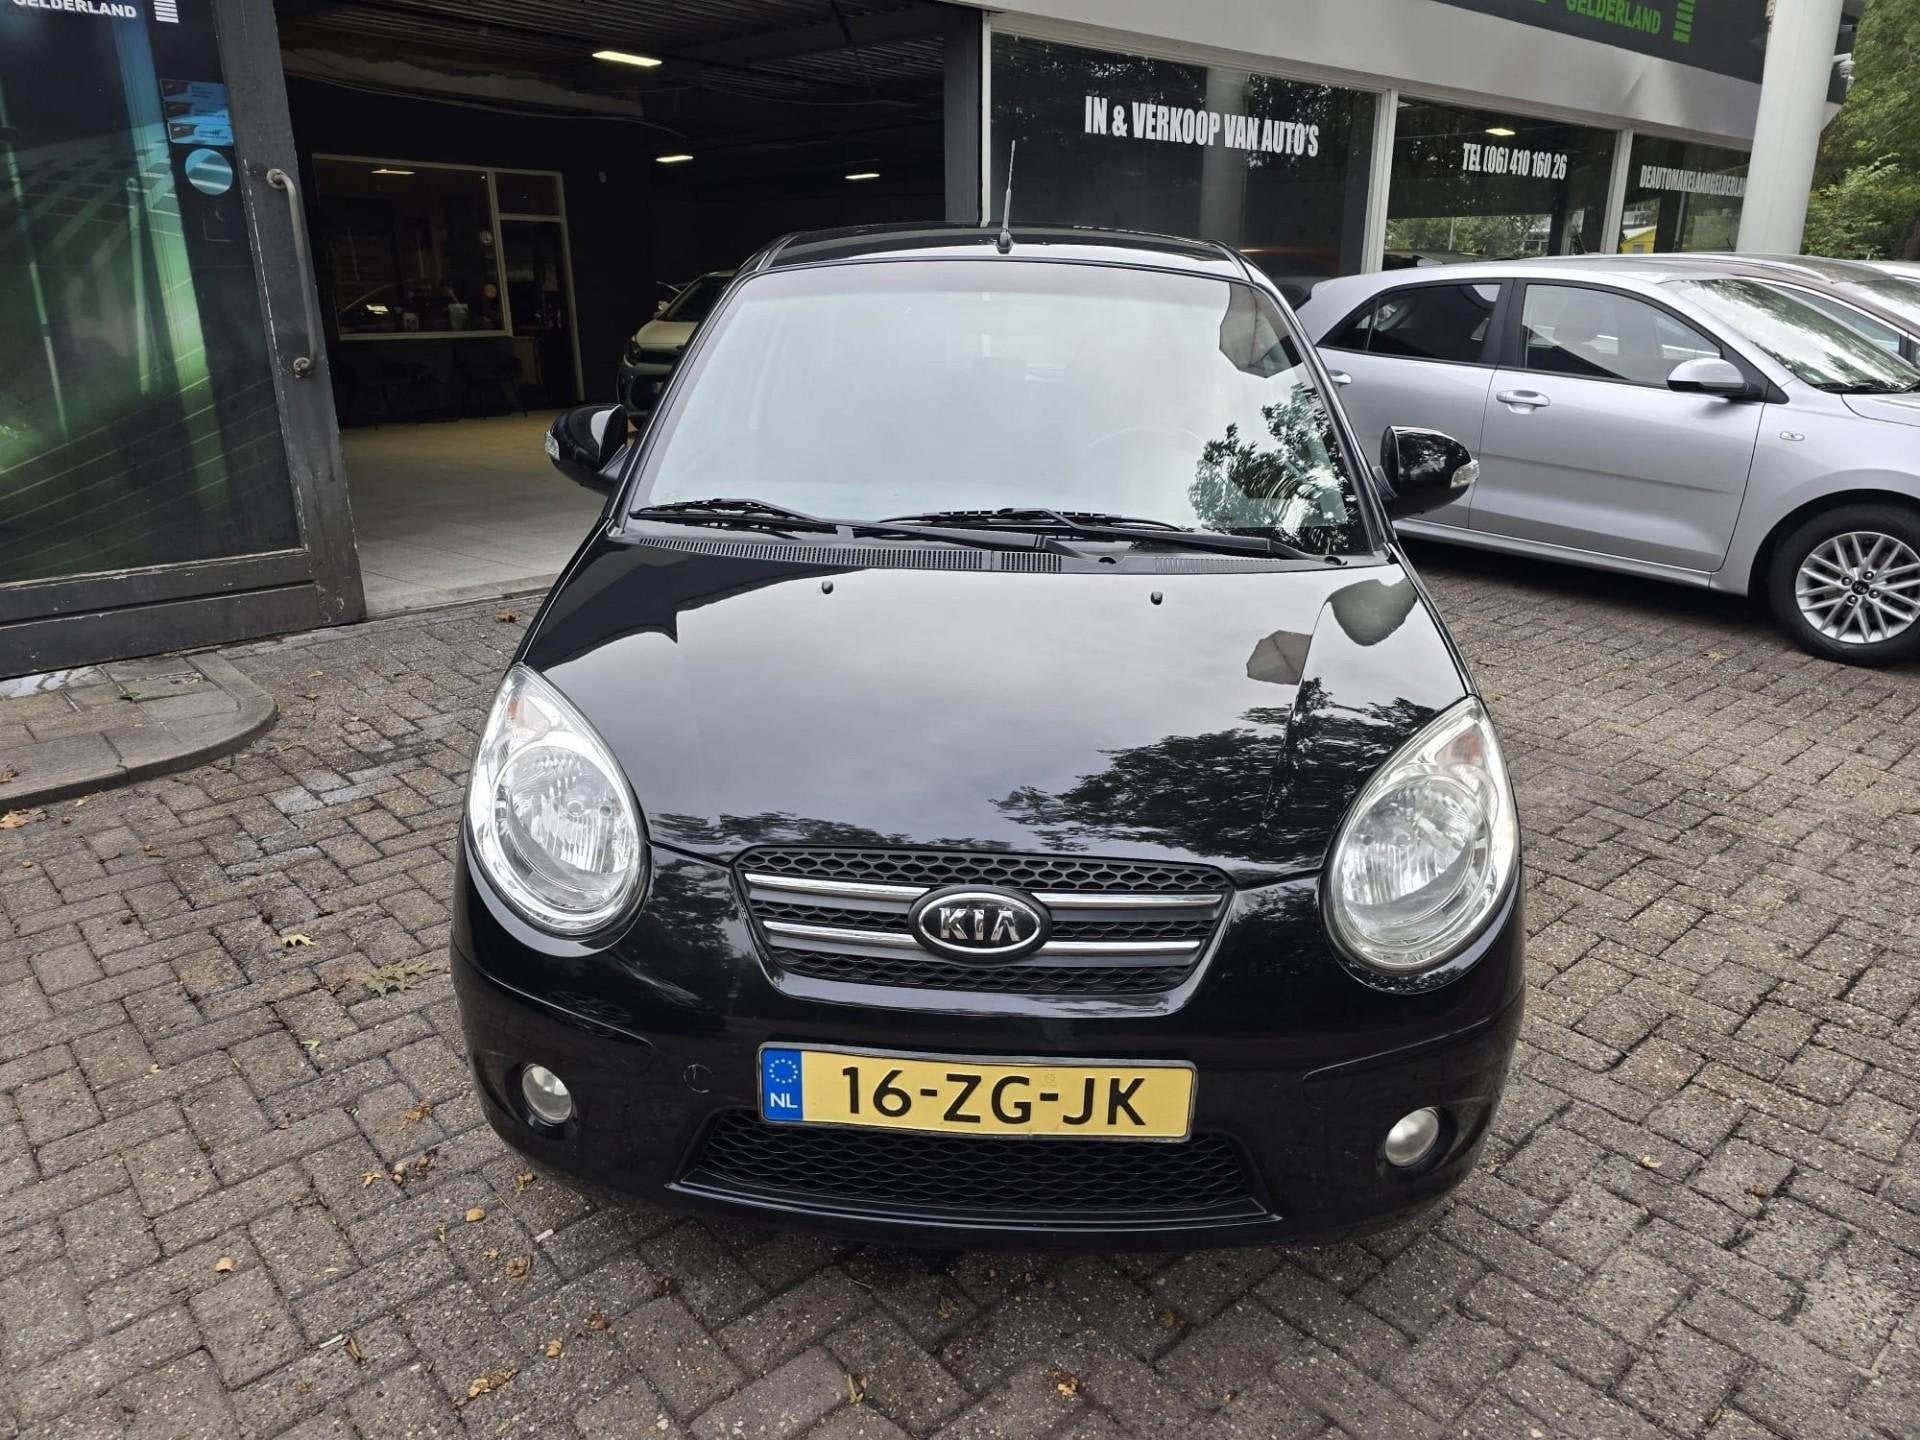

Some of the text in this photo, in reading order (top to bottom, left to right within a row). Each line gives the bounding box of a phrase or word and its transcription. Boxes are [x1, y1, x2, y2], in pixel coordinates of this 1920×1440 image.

[1085, 95, 1319, 157] IN & VERKOOP VAN AUTO'S
[1463, 142, 1568, 180] TEL (06) 410 160 26
[938, 906, 1021, 942] KIA
[770, 1091, 798, 1109] NL
[841, 1066, 1146, 1126] 16-ZG-JK
